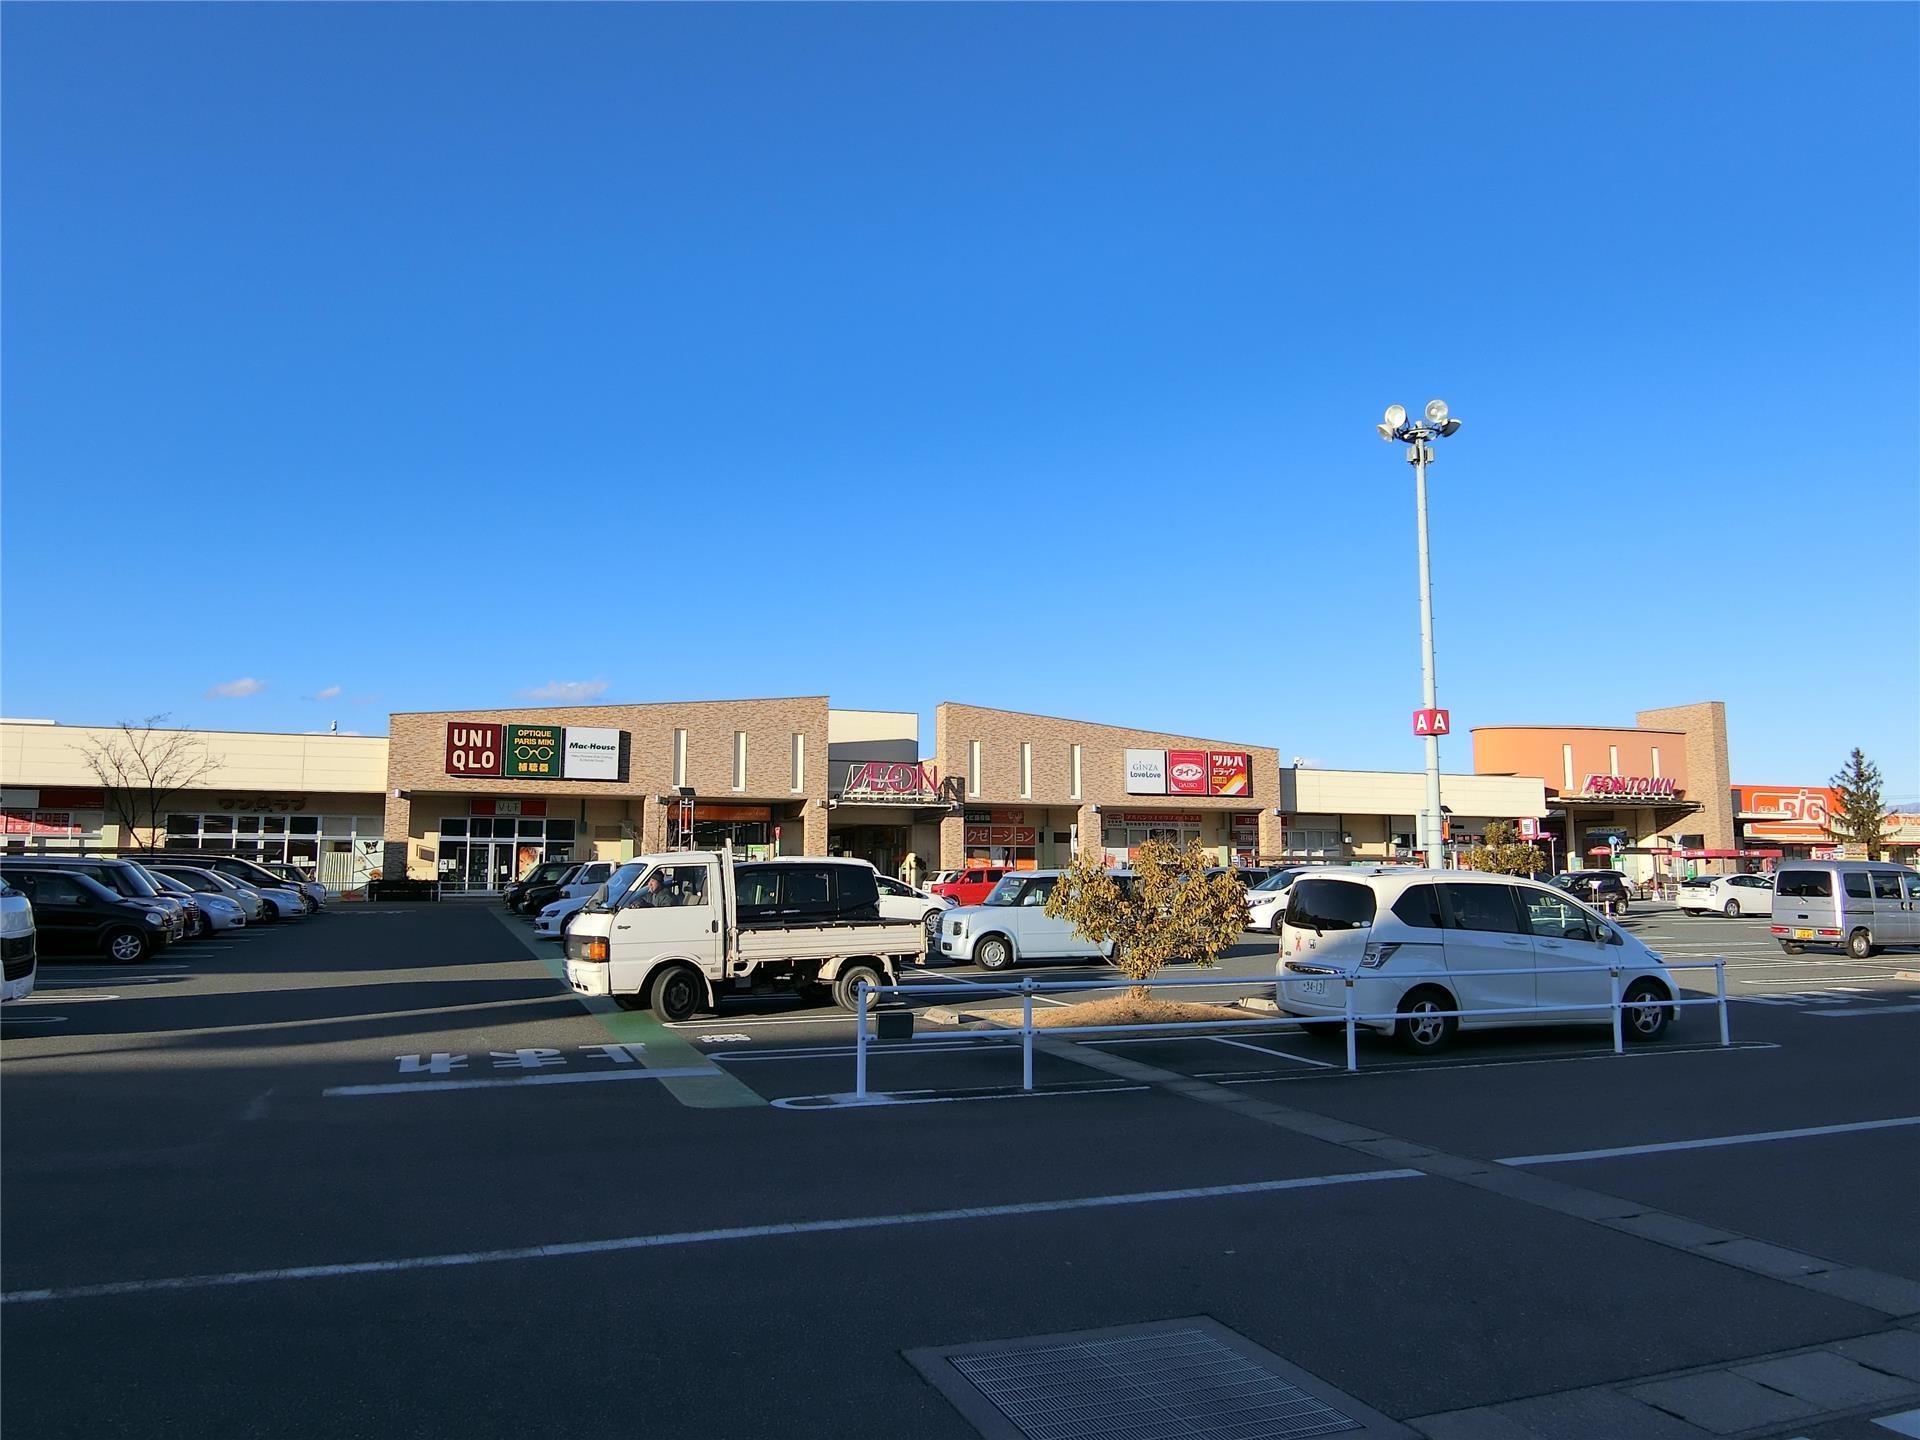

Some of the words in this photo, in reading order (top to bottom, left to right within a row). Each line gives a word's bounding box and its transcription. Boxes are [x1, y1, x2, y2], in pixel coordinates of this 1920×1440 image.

[1416, 713, 1428, 731] A
[1433, 712, 1447, 730] A
[453, 728, 492, 748] UNI
[517, 729, 552, 737] OPTIQUE
[537, 738, 555, 746] MIKI
[452, 750, 495, 770] QLO
[1213, 755, 1244, 767] ツルハ
[1130, 771, 1161, 779] LoveLove
[1213, 768, 1237, 776] ドラッグ
